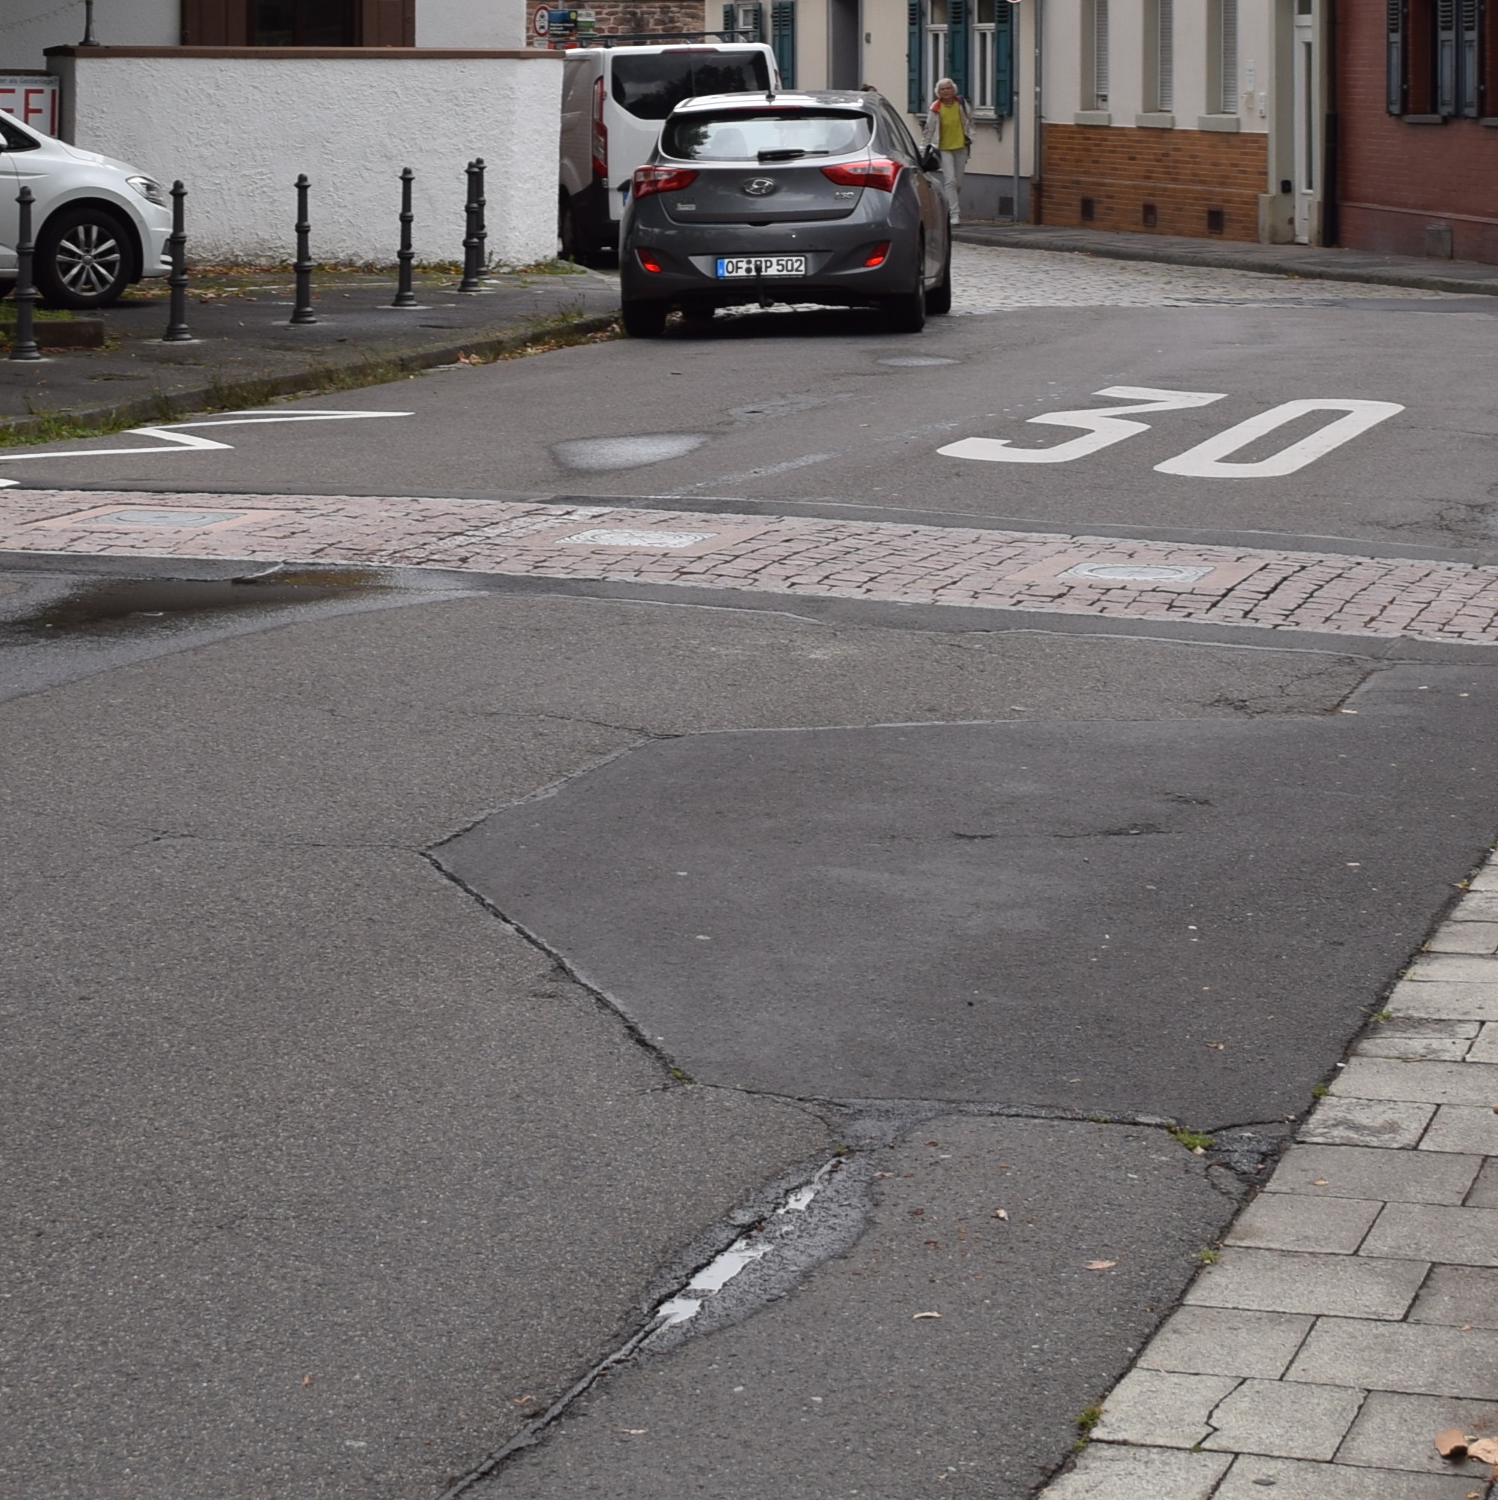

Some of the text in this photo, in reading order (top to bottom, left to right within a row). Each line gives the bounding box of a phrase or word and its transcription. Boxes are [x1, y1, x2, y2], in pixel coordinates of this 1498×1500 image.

[725, 259, 744, 274] OF
[776, 258, 803, 273] 502
[935, 386, 1406, 478] 30
